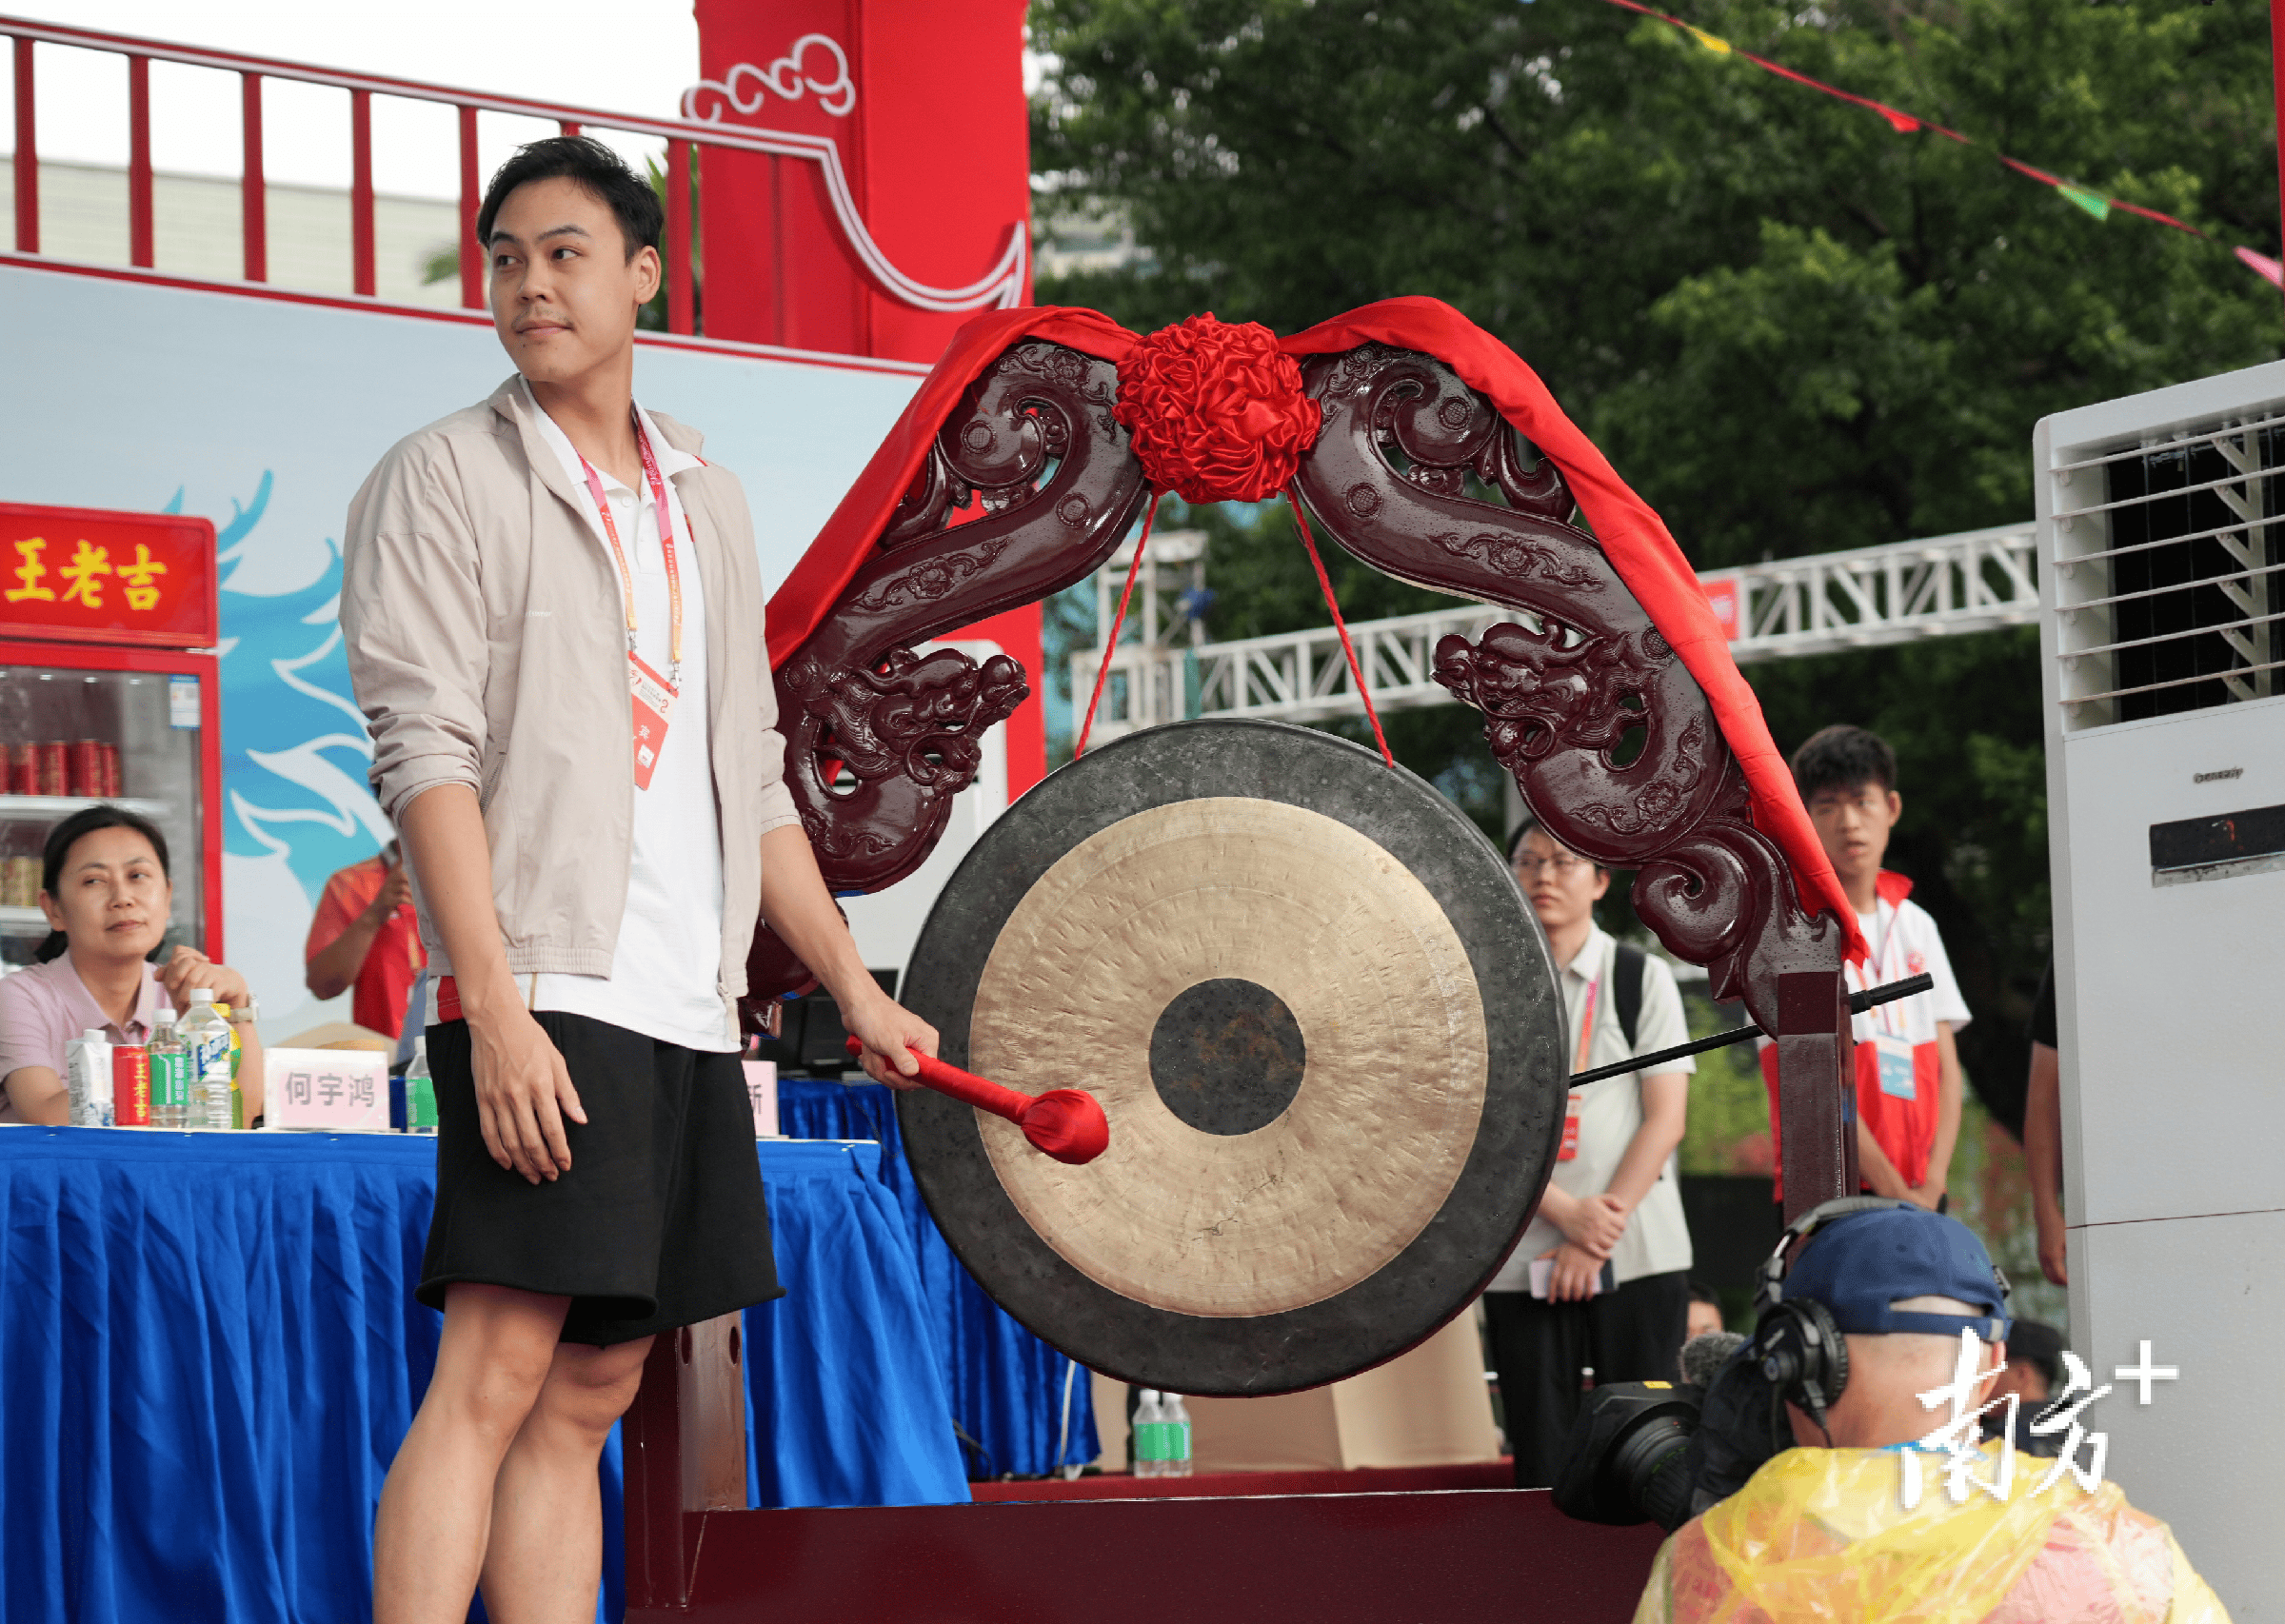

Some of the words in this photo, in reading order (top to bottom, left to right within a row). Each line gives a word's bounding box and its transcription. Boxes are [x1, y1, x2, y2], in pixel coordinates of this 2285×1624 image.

[5, 537, 168, 611] 王老吉
[285, 1071, 375, 1109] 何宇鸿
